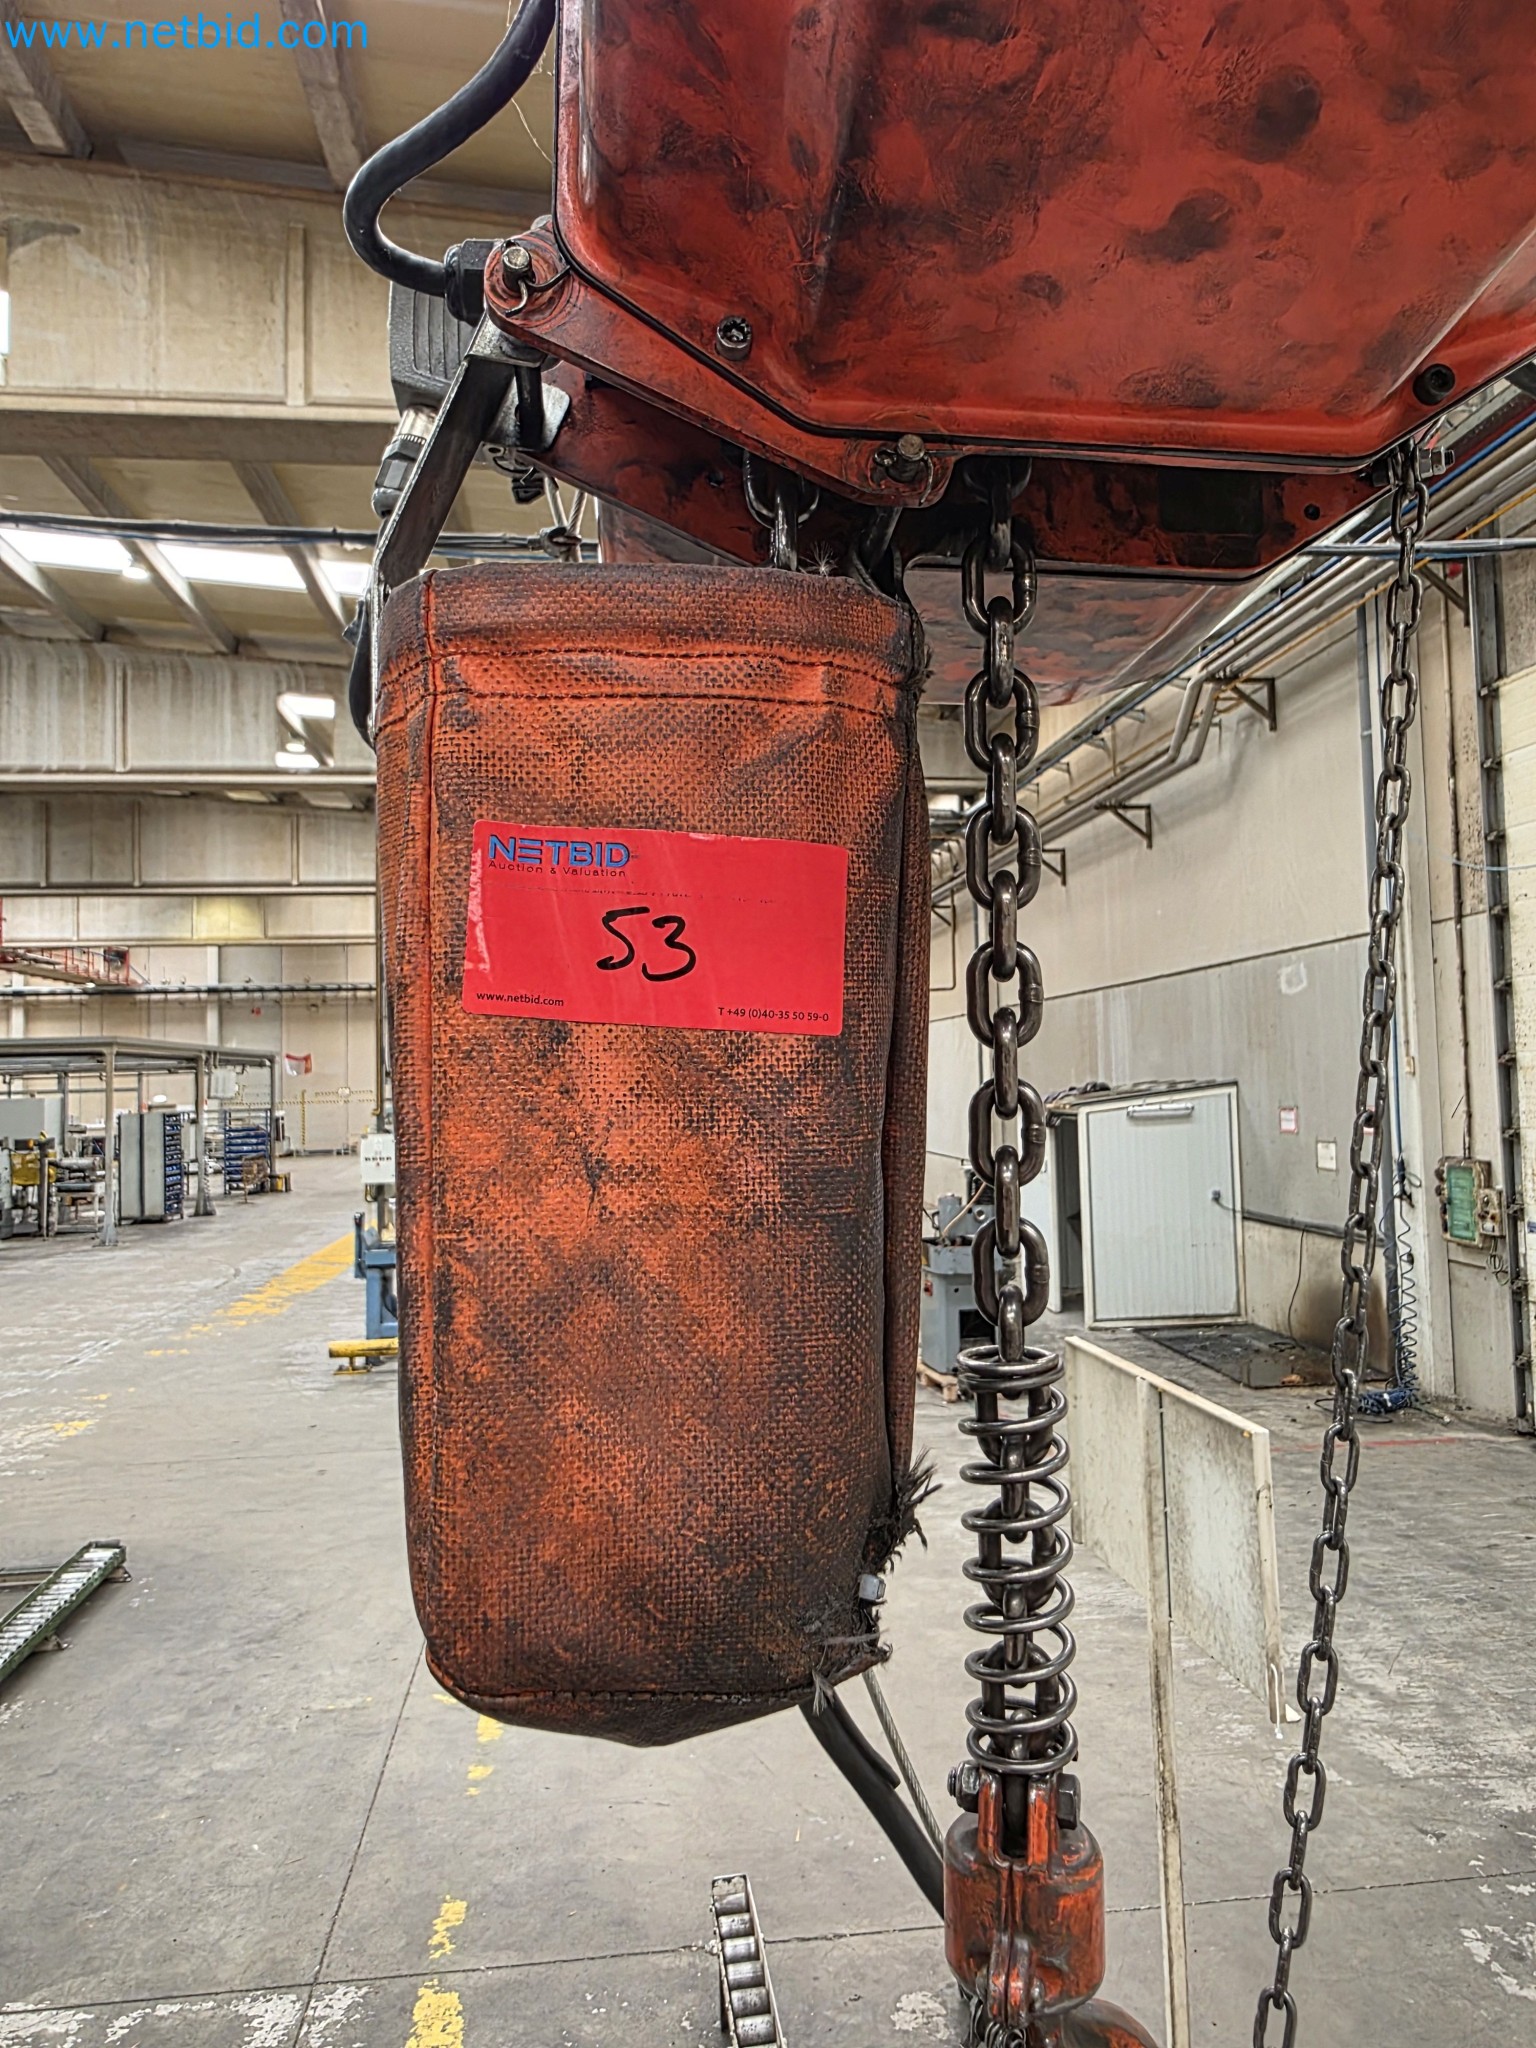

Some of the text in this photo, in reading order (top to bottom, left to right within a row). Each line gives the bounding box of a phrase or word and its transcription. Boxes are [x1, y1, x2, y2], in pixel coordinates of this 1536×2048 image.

[488, 834, 631, 868] NETBID
[488, 860, 626, 877] Auction & Valuation
[476, 992, 564, 1007] www.netbid.com
[727, 1008, 746, 1017] +49
[748, 1008, 790, 1020] (0)40-35
[792, 1011, 805, 1021] 50
[807, 1012, 829, 1022] 59-0
